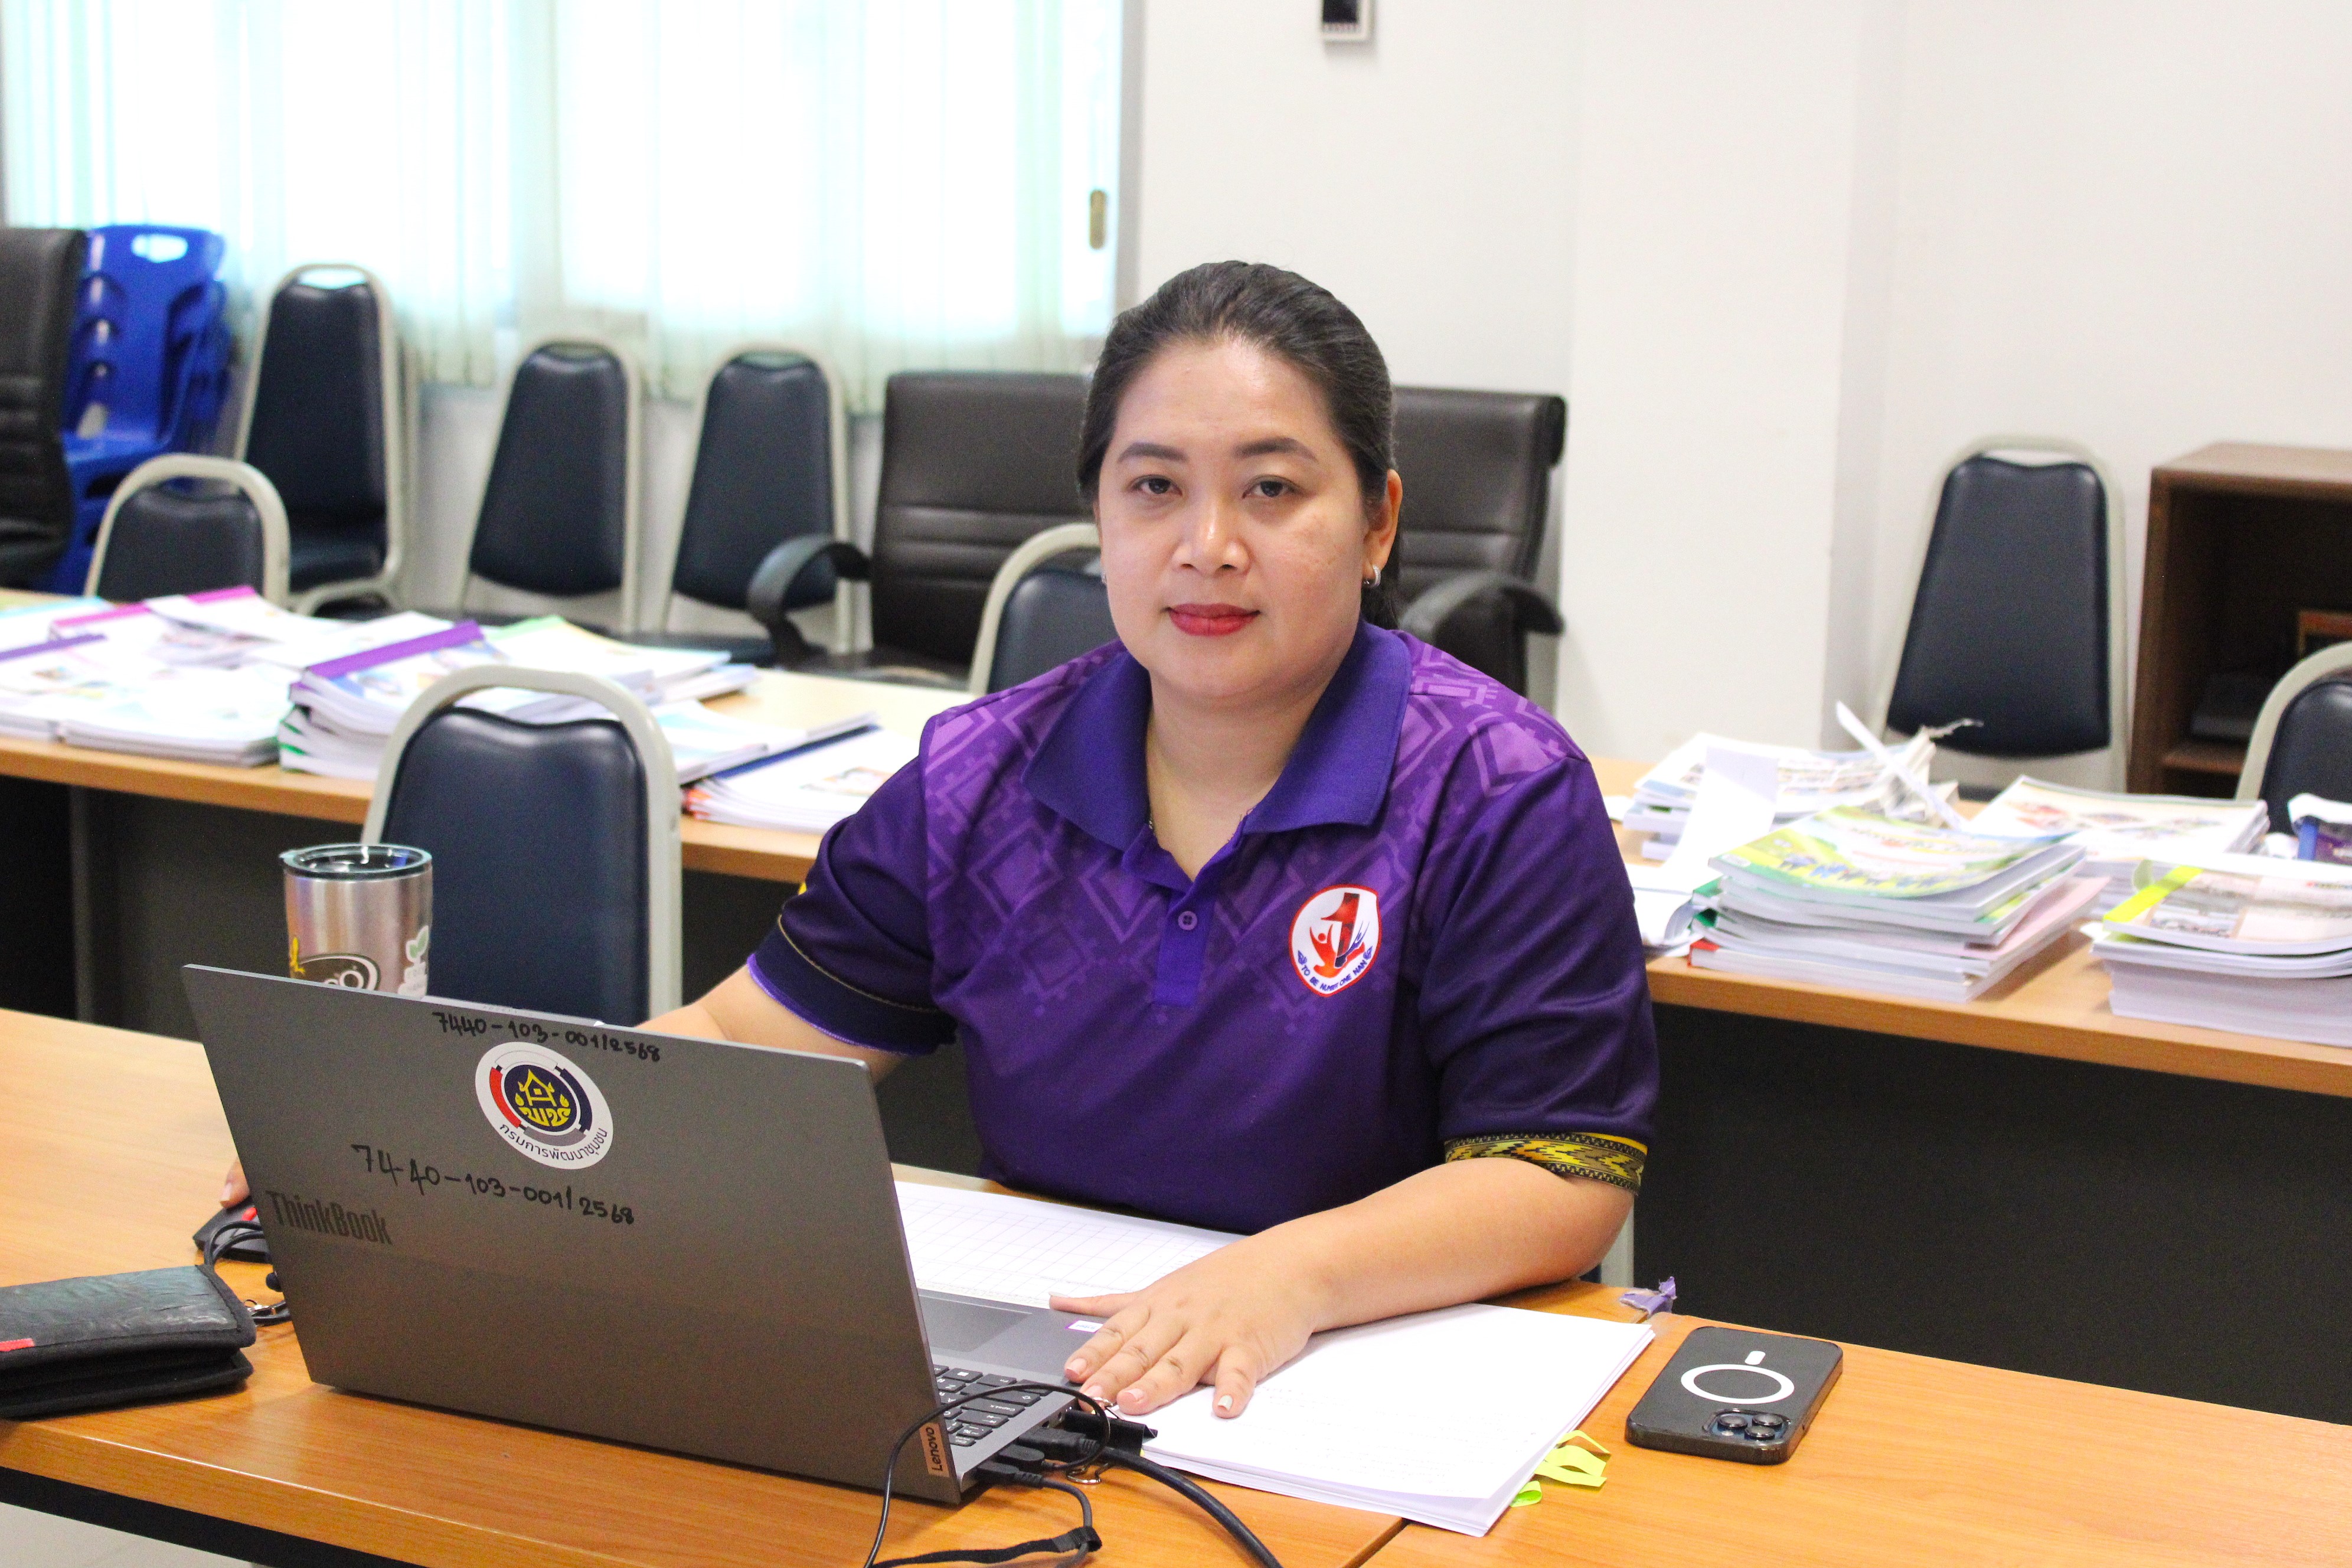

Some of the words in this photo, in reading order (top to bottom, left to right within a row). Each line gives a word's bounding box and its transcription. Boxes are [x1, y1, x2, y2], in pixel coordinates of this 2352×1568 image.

[499, 1123, 608, 1161] กรมการพัฒนาชุมชน
[266, 1190, 393, 1246] ThinkBook
[926, 1426, 943, 1472] Lenovo
